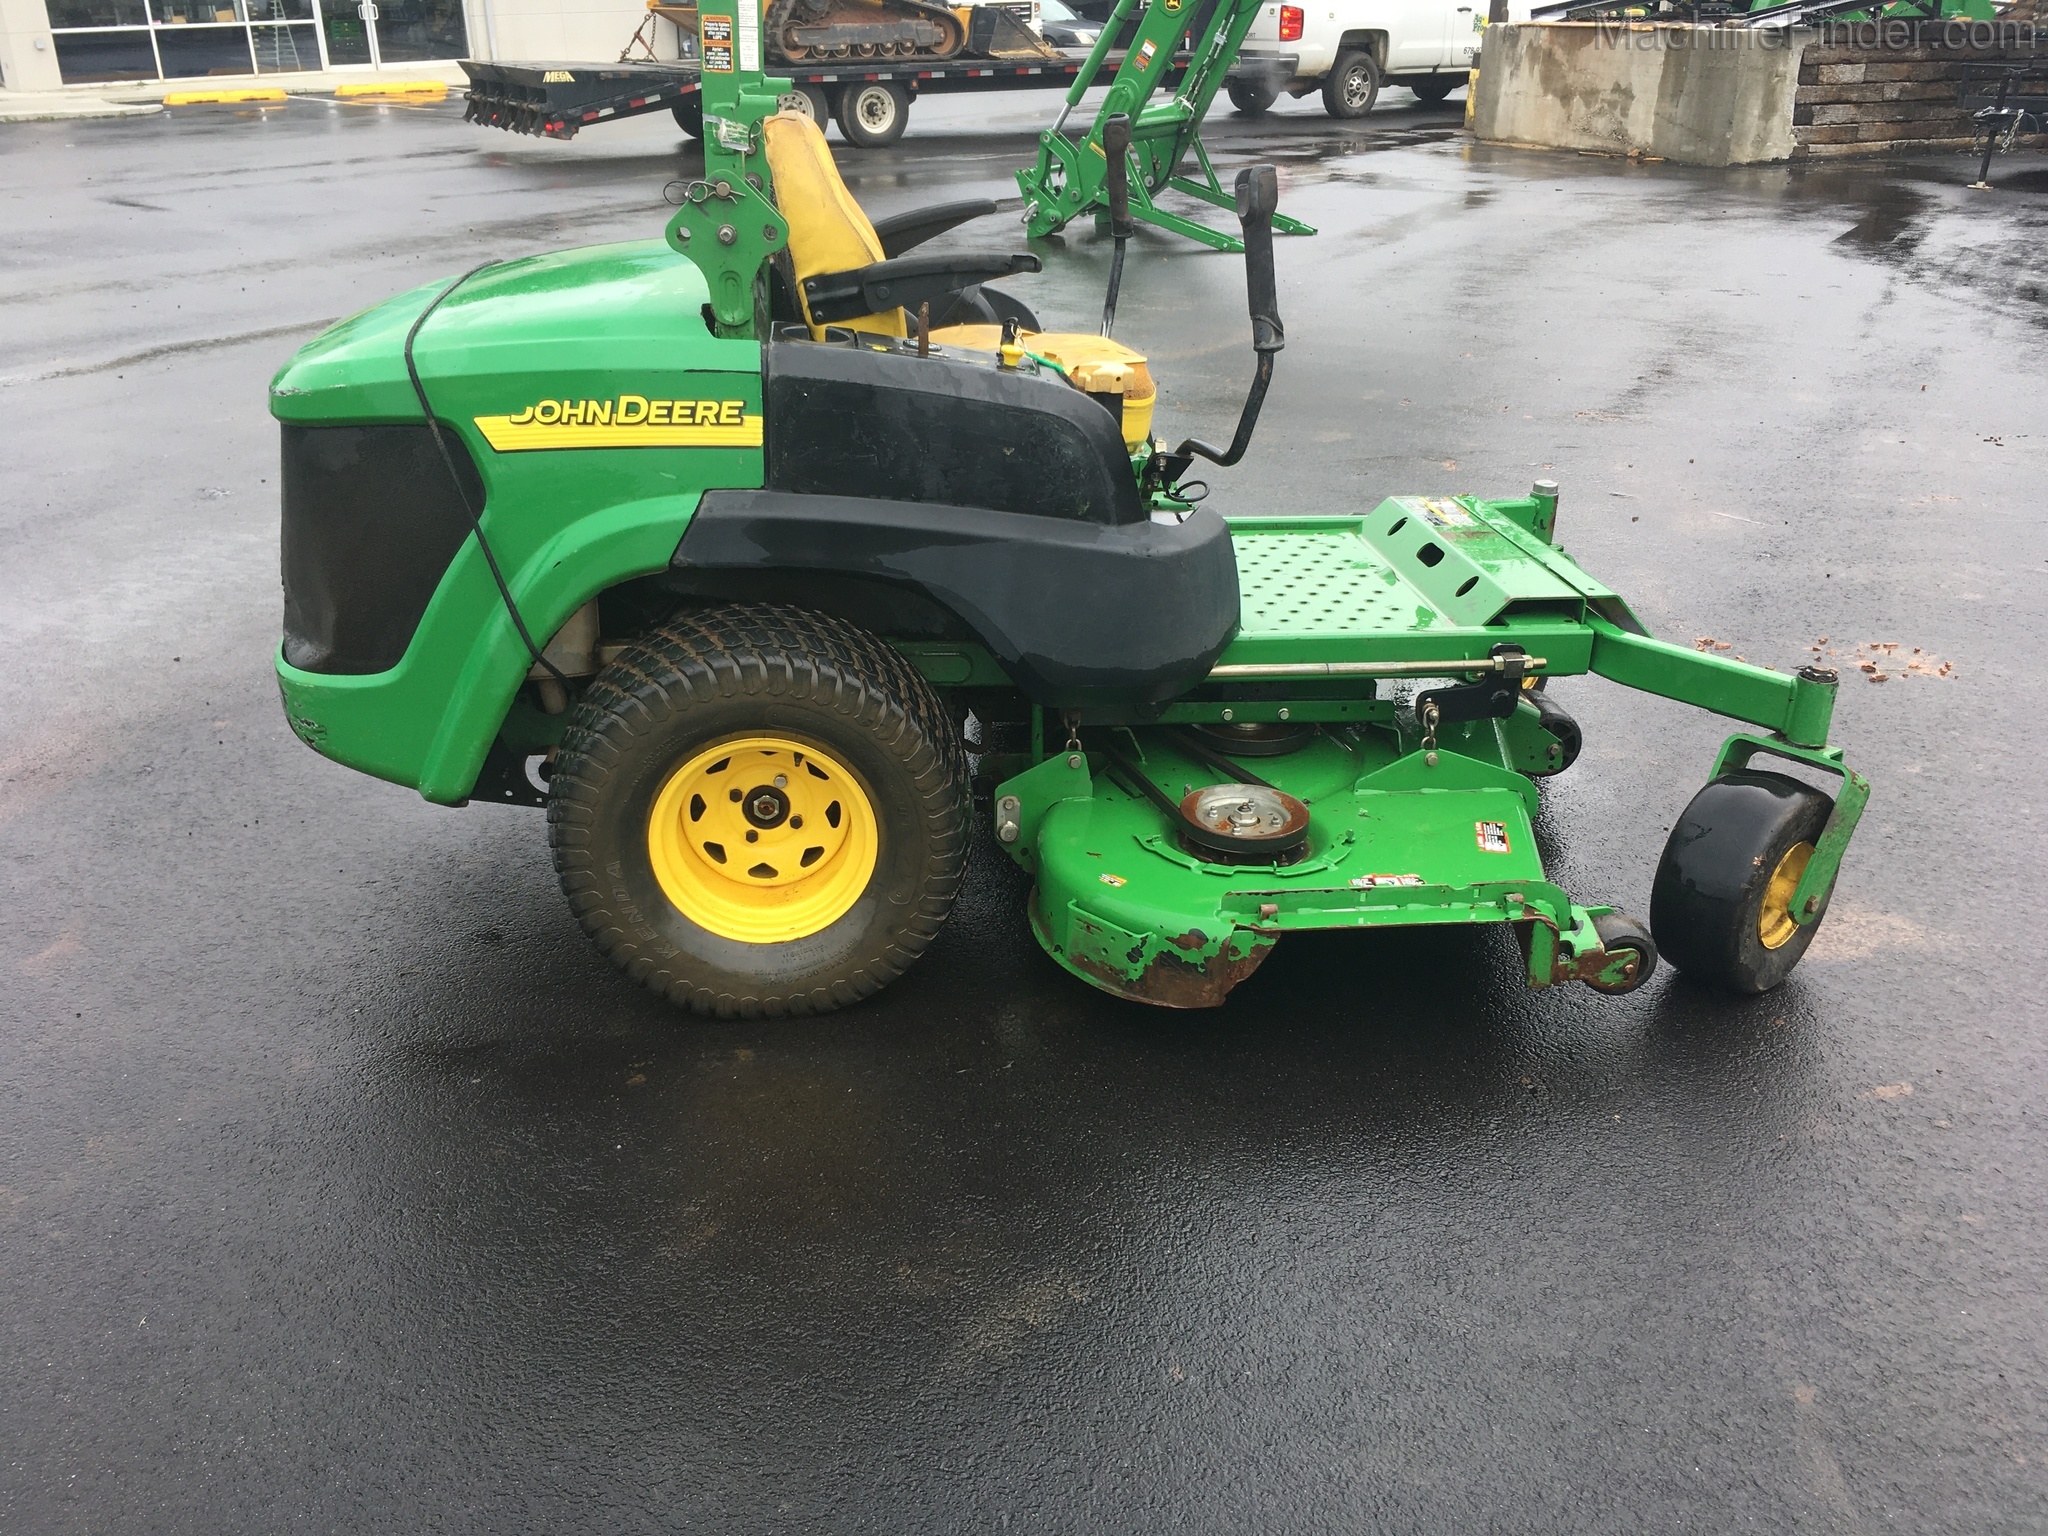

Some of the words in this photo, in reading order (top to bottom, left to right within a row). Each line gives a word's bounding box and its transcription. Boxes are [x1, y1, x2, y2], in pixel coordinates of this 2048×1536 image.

[542, 71, 576, 83] MEGA
[510, 399, 614, 425] JOHN
[615, 394, 745, 425] DEERE
[605, 860, 681, 960] KENDA
